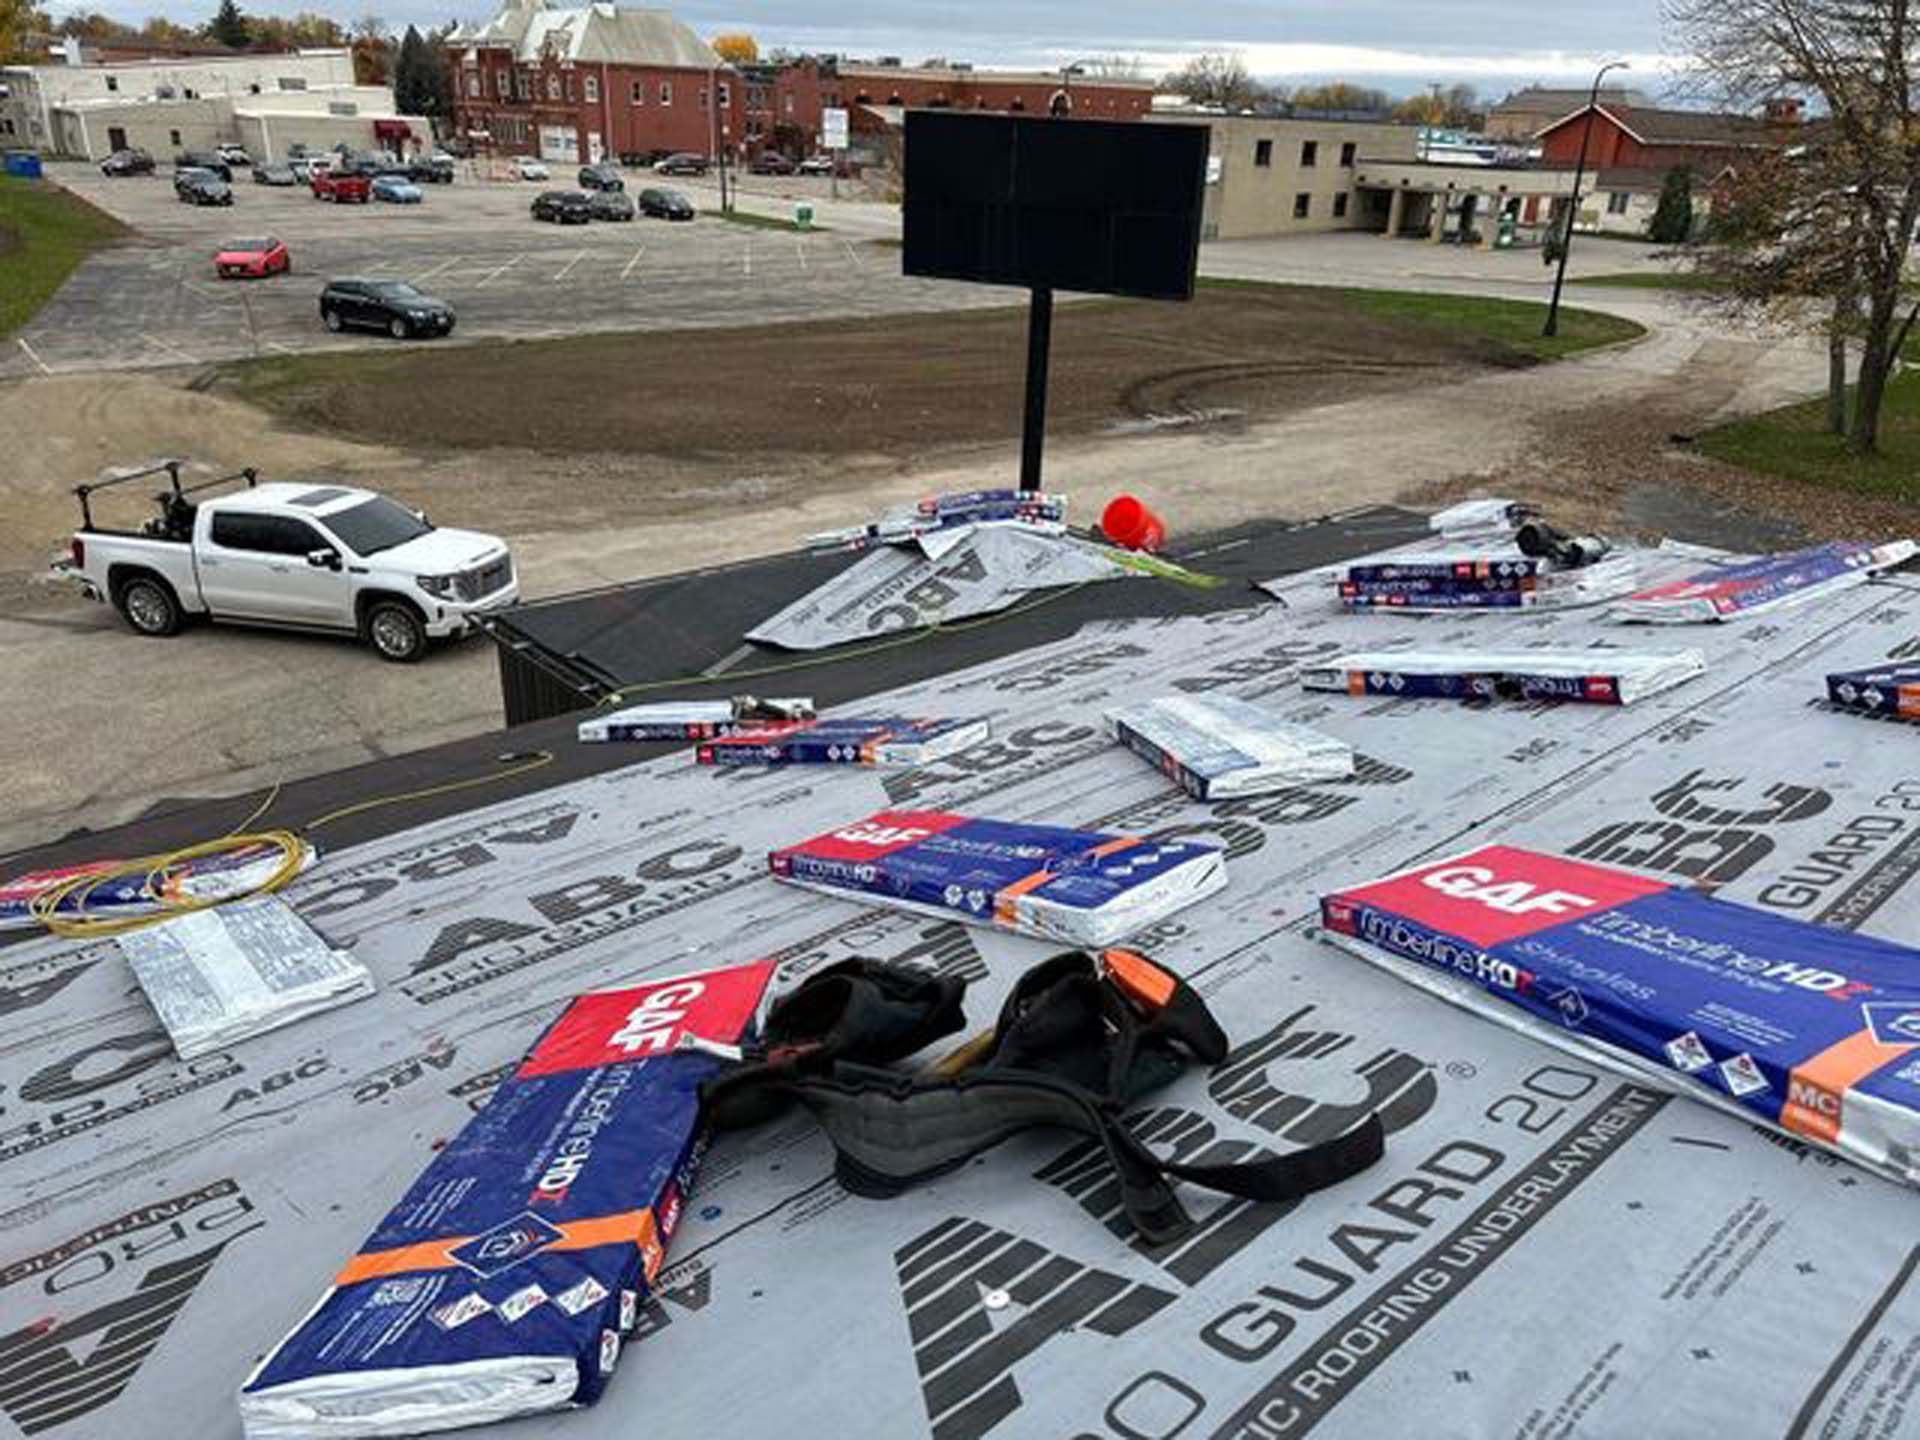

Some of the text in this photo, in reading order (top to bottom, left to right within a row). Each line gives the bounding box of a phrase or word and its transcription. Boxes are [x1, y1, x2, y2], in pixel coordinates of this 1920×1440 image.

[834, 823, 931, 845] GAF
[1565, 769, 1833, 895] BC
[1757, 815, 1904, 908] GUARD
[410, 836, 743, 977] ABC
[1420, 866, 1598, 914] GAF
[607, 982, 706, 1052] GAF
[221, 1056, 334, 1113] ABC
[1200, 1140, 1508, 1364] GUARD
[1485, 1065, 1598, 1134] 20
[1291, 1267, 1451, 1400] ROOFING
[1440, 1088, 1657, 1267] UNDERLAYMENT
